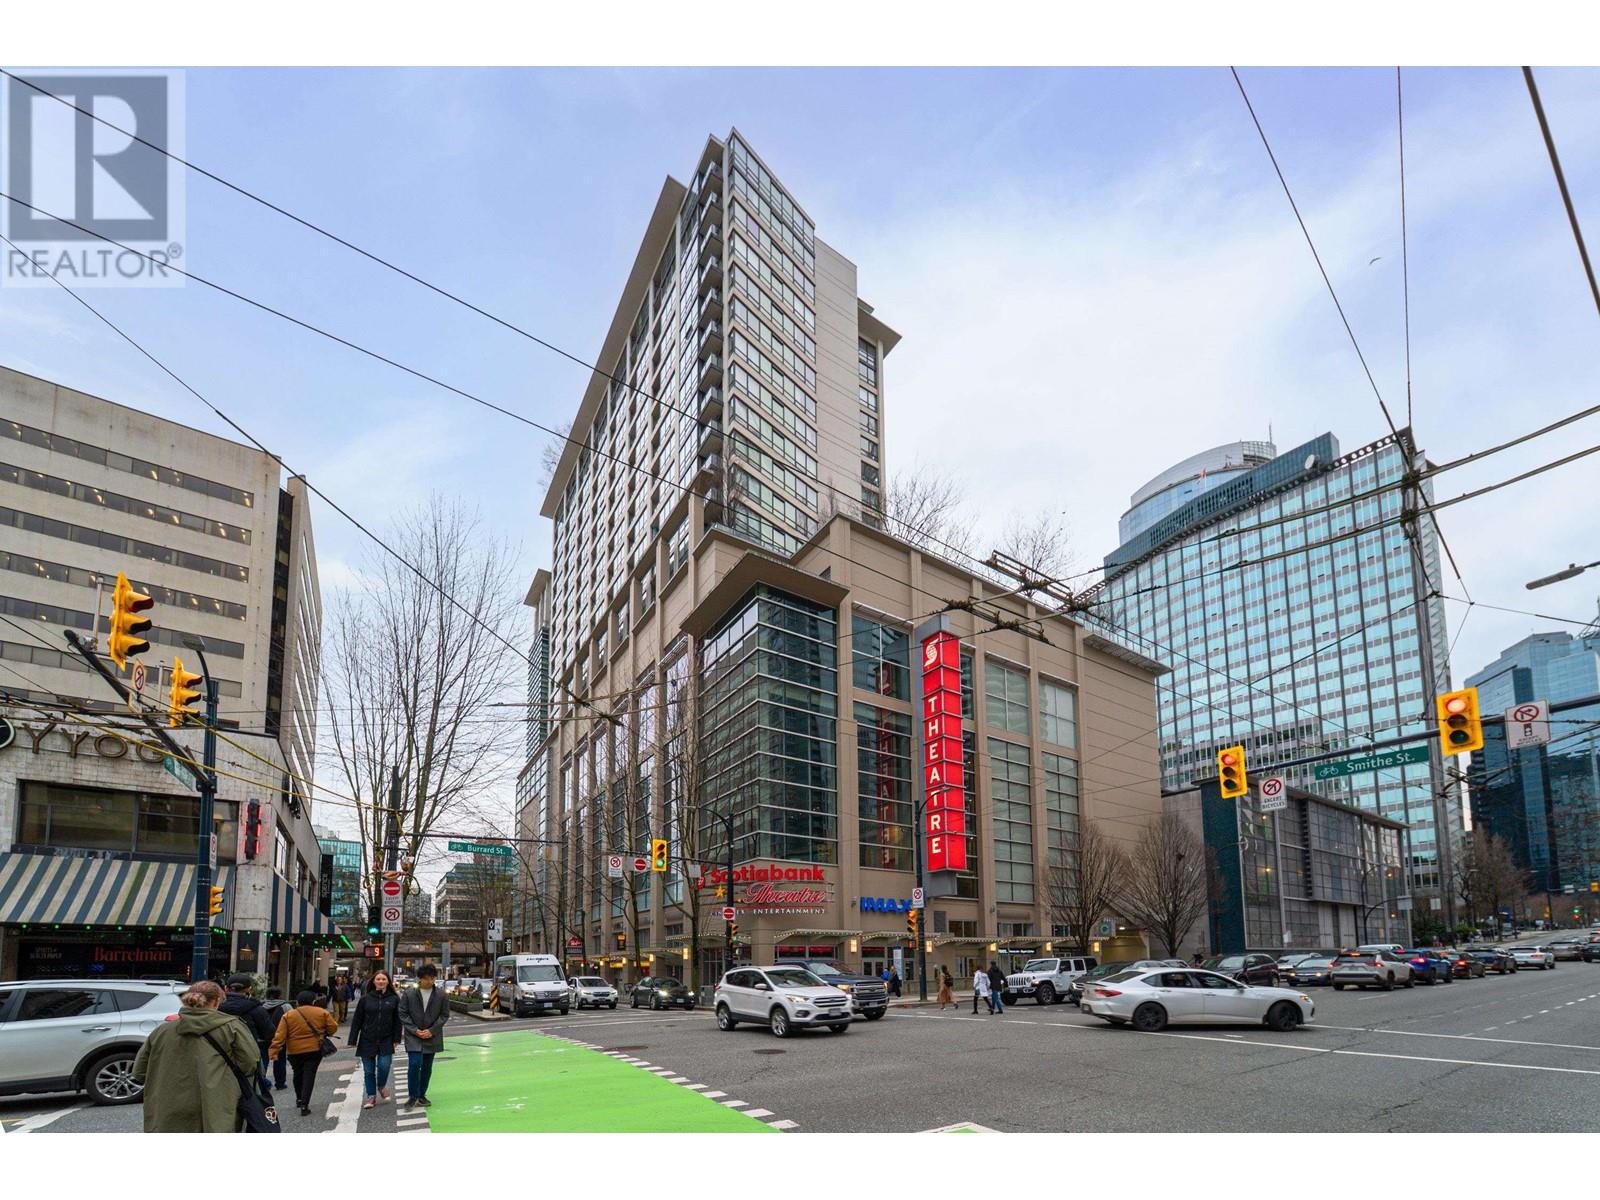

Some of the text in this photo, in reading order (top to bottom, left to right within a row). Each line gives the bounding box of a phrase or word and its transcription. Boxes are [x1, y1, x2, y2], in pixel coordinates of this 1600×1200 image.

[1346, 752, 1415, 773] Smithe St.
[927, 697, 942, 853] THEATRE
[467, 845, 506, 855] Burrard St.
[710, 864, 825, 884] Scotiabank
[860, 896, 913, 913] IMAX
[94, 945, 173, 962] Barrelman
